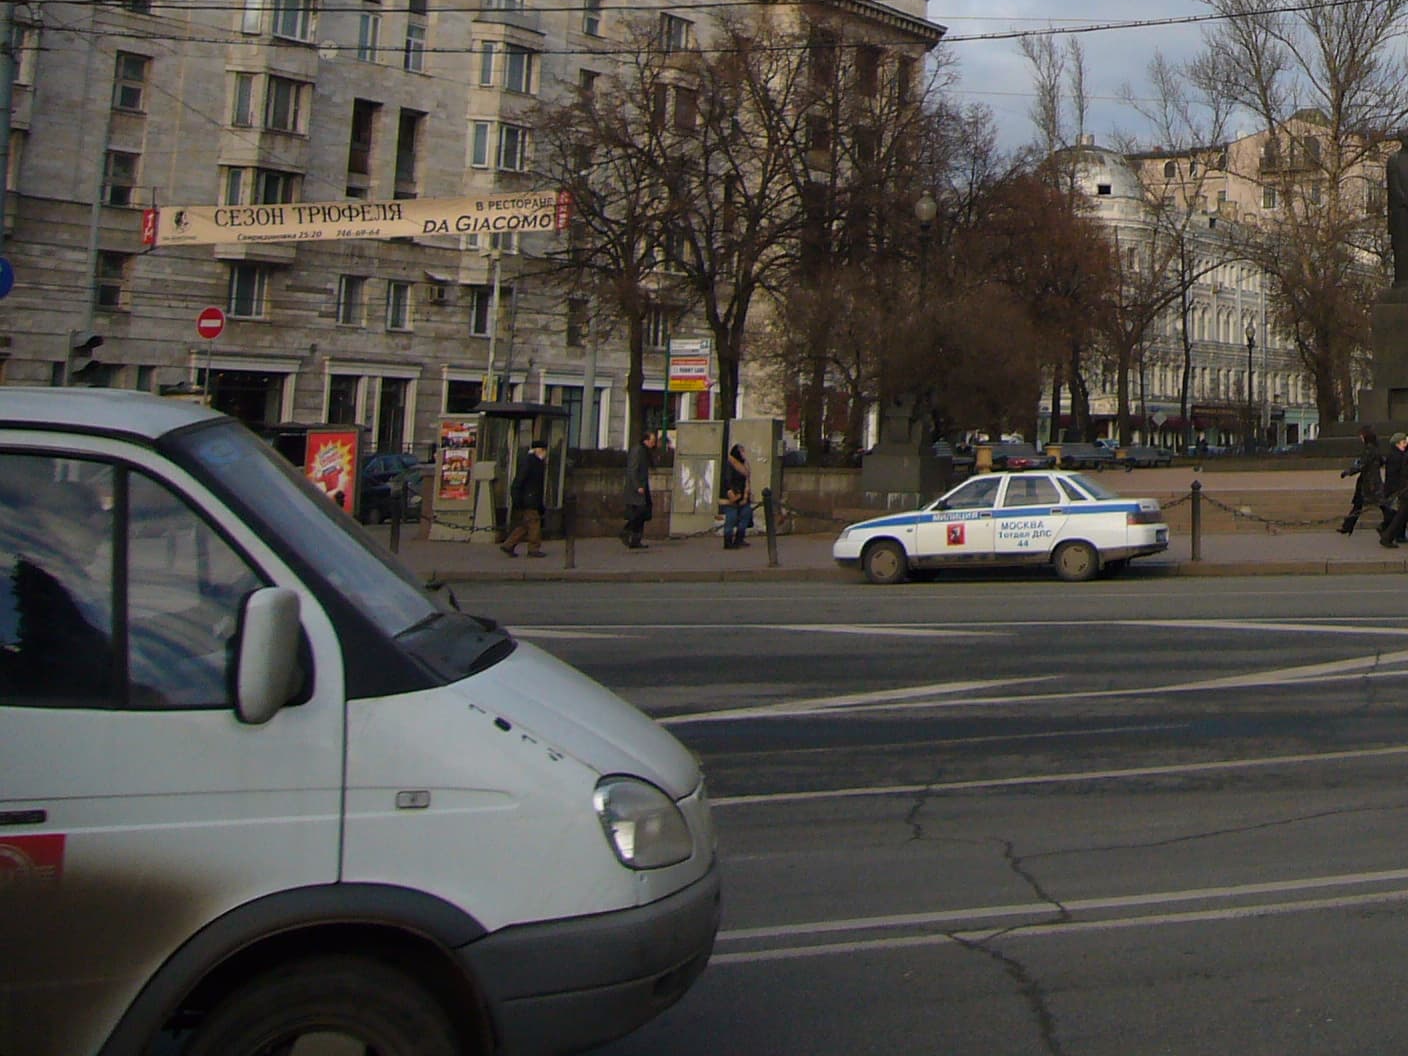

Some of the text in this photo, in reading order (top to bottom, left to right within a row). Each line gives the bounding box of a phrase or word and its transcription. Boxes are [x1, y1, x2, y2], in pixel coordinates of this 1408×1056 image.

[474, 200, 485, 212] В
[214, 203, 402, 227] СЕЗОН ТРЮФЕЛЯ
[422, 213, 553, 234] DA GIACOMO
[932, 511, 979, 522] МИЛИЦИЯ
[1001, 520, 1045, 531] МОСКВА
[1031, 529, 1053, 539] ДПС
